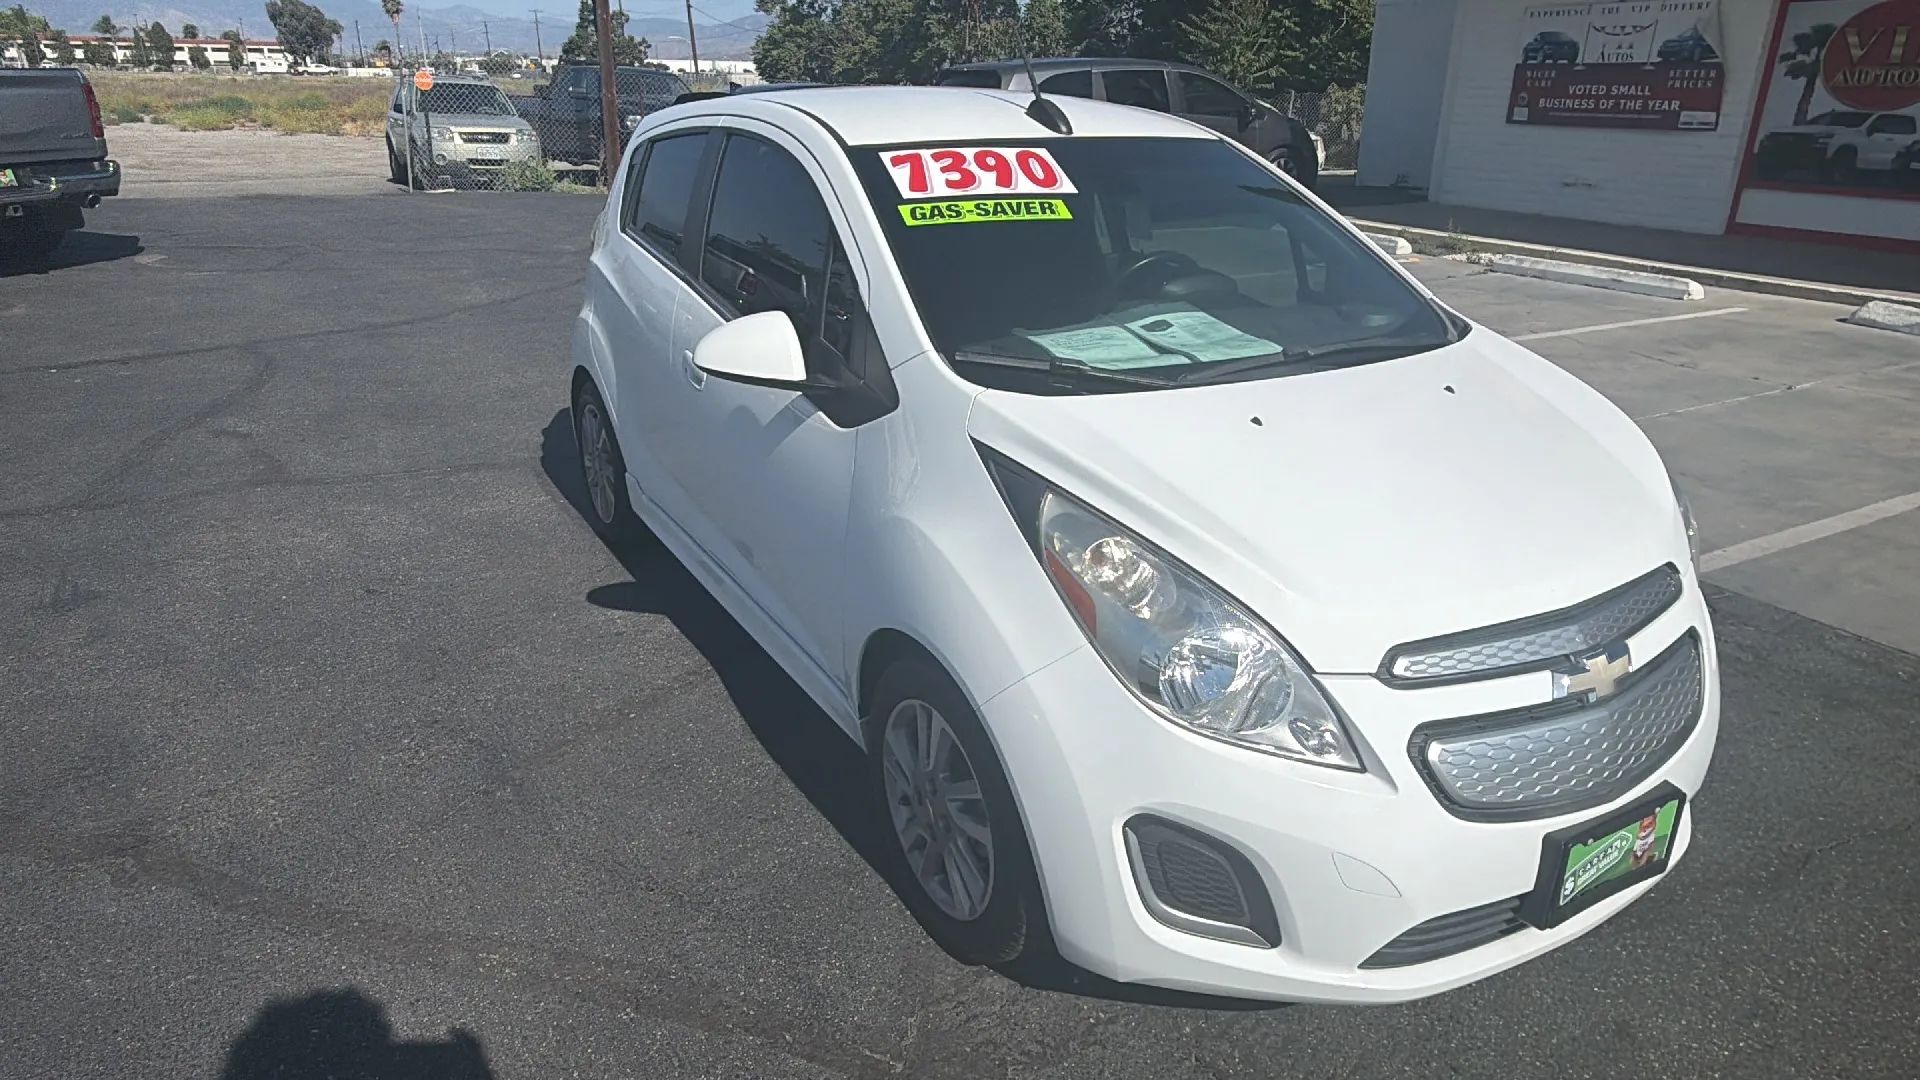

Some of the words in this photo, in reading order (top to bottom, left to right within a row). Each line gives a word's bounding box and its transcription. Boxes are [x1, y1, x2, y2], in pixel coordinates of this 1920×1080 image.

[1530, 5, 1592, 18] EXPERIENCE
[1602, 6, 1620, 15] THE
[1631, 4, 1651, 13] VIP
[1844, 25, 1920, 64] VI
[1669, 69, 1717, 78] BETTER
[1568, 85, 1606, 95] VOTED
[1610, 85, 1651, 96] SMALL
[1667, 80, 1713, 88] PRICES
[1538, 98, 1595, 109] BUSINESS
[1599, 99, 1615, 109] OF
[1619, 99, 1643, 110] THE
[1647, 99, 1681, 111] YEAR
[889, 149, 1063, 194] 7390
[908, 200, 1058, 222] GAS-SAVER
